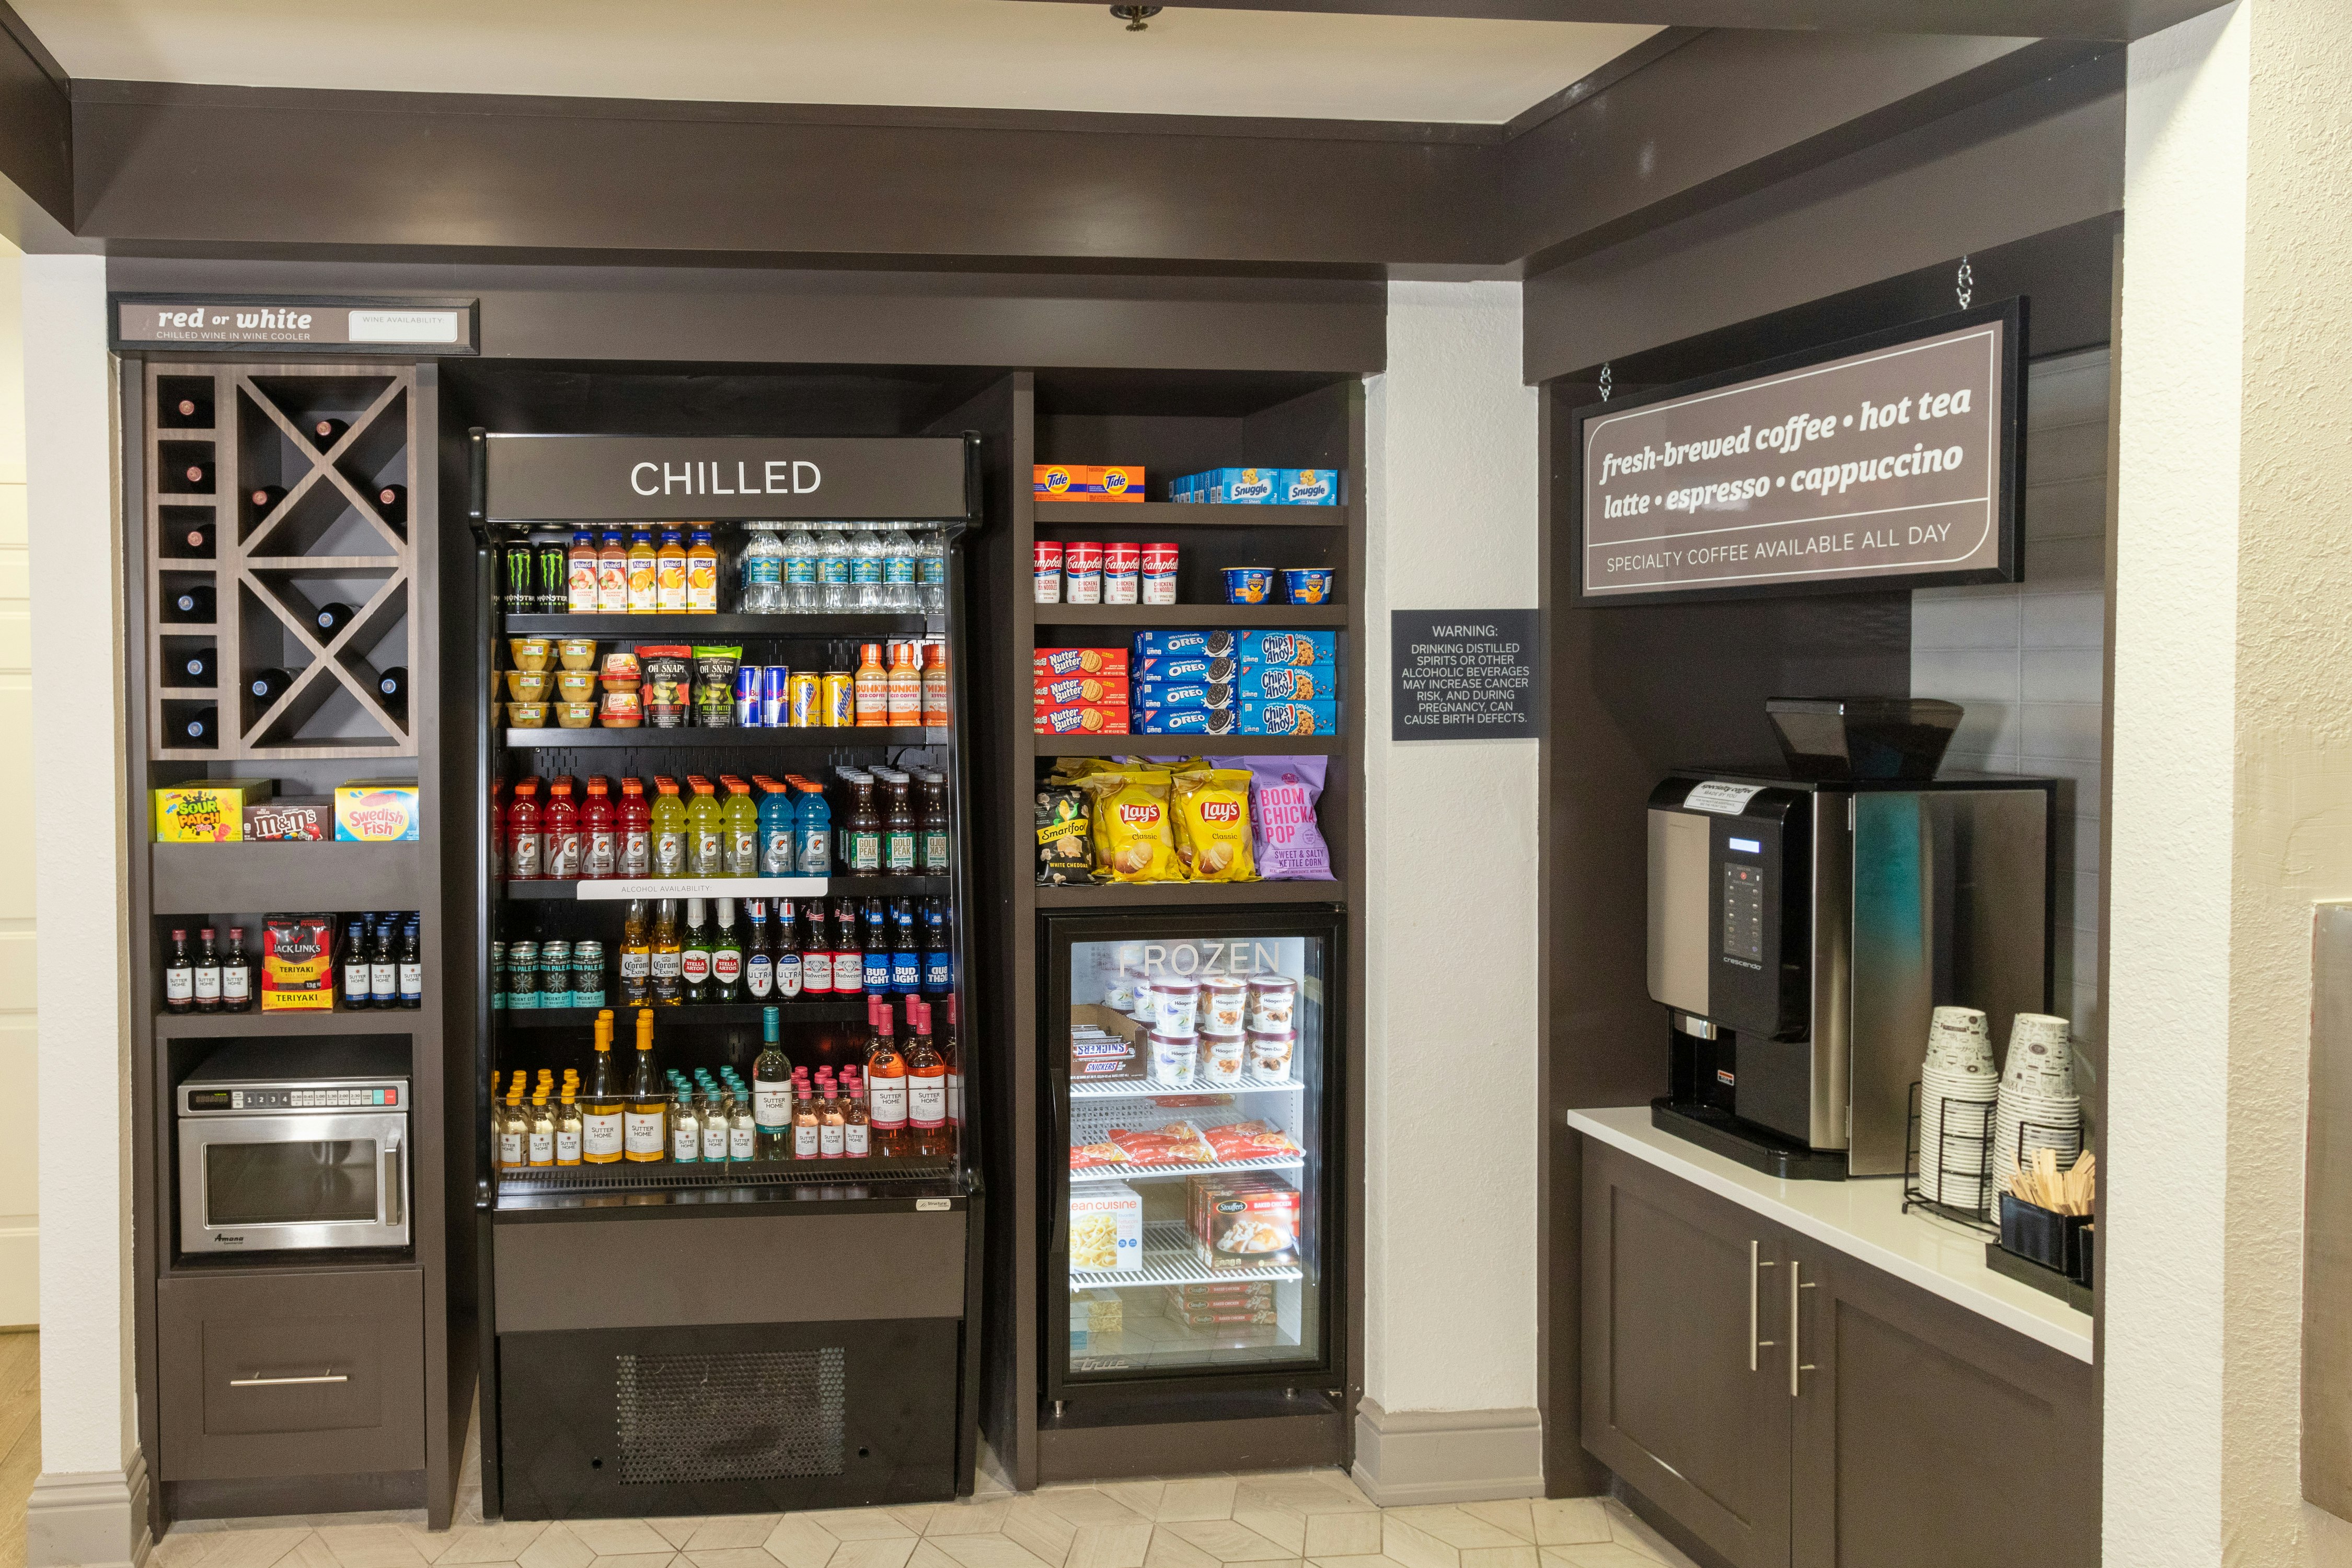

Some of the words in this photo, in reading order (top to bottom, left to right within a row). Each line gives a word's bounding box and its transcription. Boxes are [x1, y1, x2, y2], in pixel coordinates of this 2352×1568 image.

[158, 308, 204, 328] red
[212, 314, 229, 326] or
[237, 309, 312, 329] white
[271, 332, 310, 341] COOLER
[1599, 425, 1751, 486] fresh-brewed
[1755, 414, 1837, 454] coffee
[1859, 397, 1912, 432] hot
[1918, 389, 1971, 420] tea
[630, 460, 821, 495] CHILLED
[1047, 473, 1068, 488] Tide
[1105, 475, 1126, 489] Tide
[1605, 493, 1650, 519] latte
[1666, 474, 1770, 514] espresso
[1791, 443, 1963, 495] cappuccino
[1235, 484, 1267, 497] Snuggle
[1292, 485, 1325, 498] Snuggle
[1607, 551, 1682, 573] SPECIALTY
[1688, 544, 1748, 564] COFFEE
[1754, 533, 1854, 559] AVAILABLE
[1861, 528, 1900, 549] ALL
[1908, 523, 1952, 545] DAY
[1432, 625, 1498, 637] WARNING:
[1168, 637, 1204, 650] OREO
[1263, 635, 1288, 653] Chips
[1295, 633, 1315, 645] ORIGINAL
[1412, 644, 1463, 654] DRINKING
[1467, 643, 1519, 653] DISTILLED
[1050, 650, 1078, 665] Nutter
[1417, 656, 1457, 665] SPIRITS
[1460, 655, 1475, 665] OR
[1478, 655, 1514, 665] OTHER
[1054, 657, 1081, 674] Butter
[1169, 664, 1205, 676] OREO
[1402, 667, 1463, 677] ALCOHOLIC
[1467, 666, 1529, 676] BEVERAGES
[1403, 679, 1426, 689] MAY
[1429, 679, 1481, 689] INCREASE
[1484, 678, 1528, 688] CANCER
[1417, 691, 1443, 701] RISK,
[1446, 691, 1470, 700] AND
[1473, 690, 1515, 700] DURING
[1419, 702, 1486, 713] PREGNANCY,
[1491, 701, 1513, 711] CAN
[1169, 715, 1205, 728] OREO
[1404, 715, 1439, 724] CAUSE
[1443, 714, 1474, 724] BIRTH
[1478, 713, 1527, 723] DEFECTS.
[1261, 788, 1305, 806] BOOM
[179, 800, 217, 815] SOUR
[1123, 803, 1158, 822] Lay's
[1204, 801, 1238, 820] Lay's
[179, 812, 221, 828] PATCH
[349, 809, 405, 828] Swedish
[1263, 806, 1315, 825] CHICKA
[363, 821, 394, 837] Fish
[1266, 825, 1295, 843] POP
[593, 837, 609, 856] G
[807, 835, 824, 854] G
[859, 839, 876, 847] GOLD
[1279, 859, 1302, 867] KETTLE
[274, 944, 294, 953] JACK
[295, 944, 320, 953] LINK'S
[653, 960, 679, 970] Corona
[1120, 942, 1279, 977] FROZEN
[1724, 956, 1761, 970] crescendo
[895, 967, 916, 975] BUD
[893, 974, 919, 983] LIGHT
[1087, 1063, 1116, 1071] SNICKERS
[1070, 1202, 1093, 1210] ean
[1096, 1201, 1136, 1209] cuisine
[1220, 1203, 1243, 1212] Stouffer's
[214, 1233, 244, 1242] Amana
